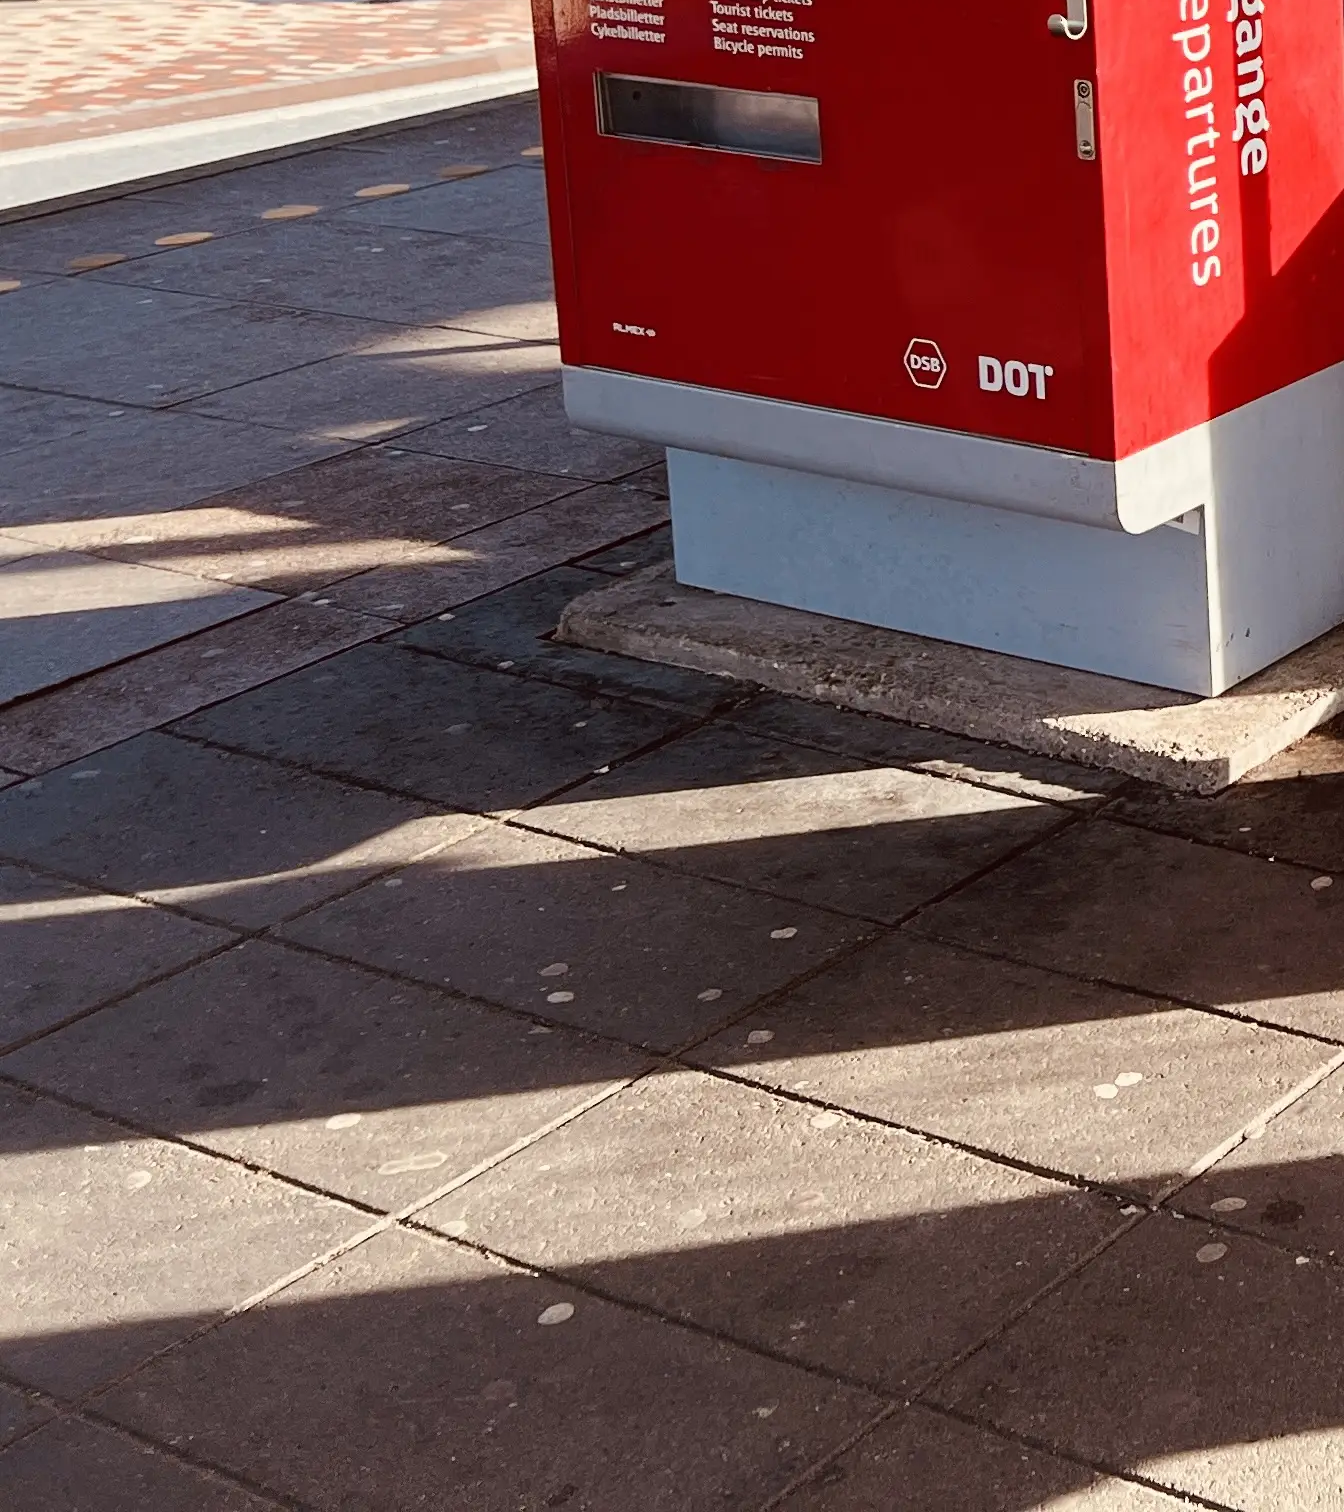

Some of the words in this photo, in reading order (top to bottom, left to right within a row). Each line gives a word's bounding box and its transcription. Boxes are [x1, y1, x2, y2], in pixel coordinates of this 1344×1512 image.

[589, 5, 664, 25] Pladsbilletter
[709, 0, 751, 18] Tourist
[754, 6, 794, 22] tickets
[591, 22, 665, 43] Cykelbilletter
[712, 18, 738, 34] Seat
[741, 24, 815, 43] reservations
[714, 36, 754, 54] Bicycle
[757, 44, 804, 59] permits
[910, 354, 941, 372] DSB
[978, 355, 1046, 399] DOT
